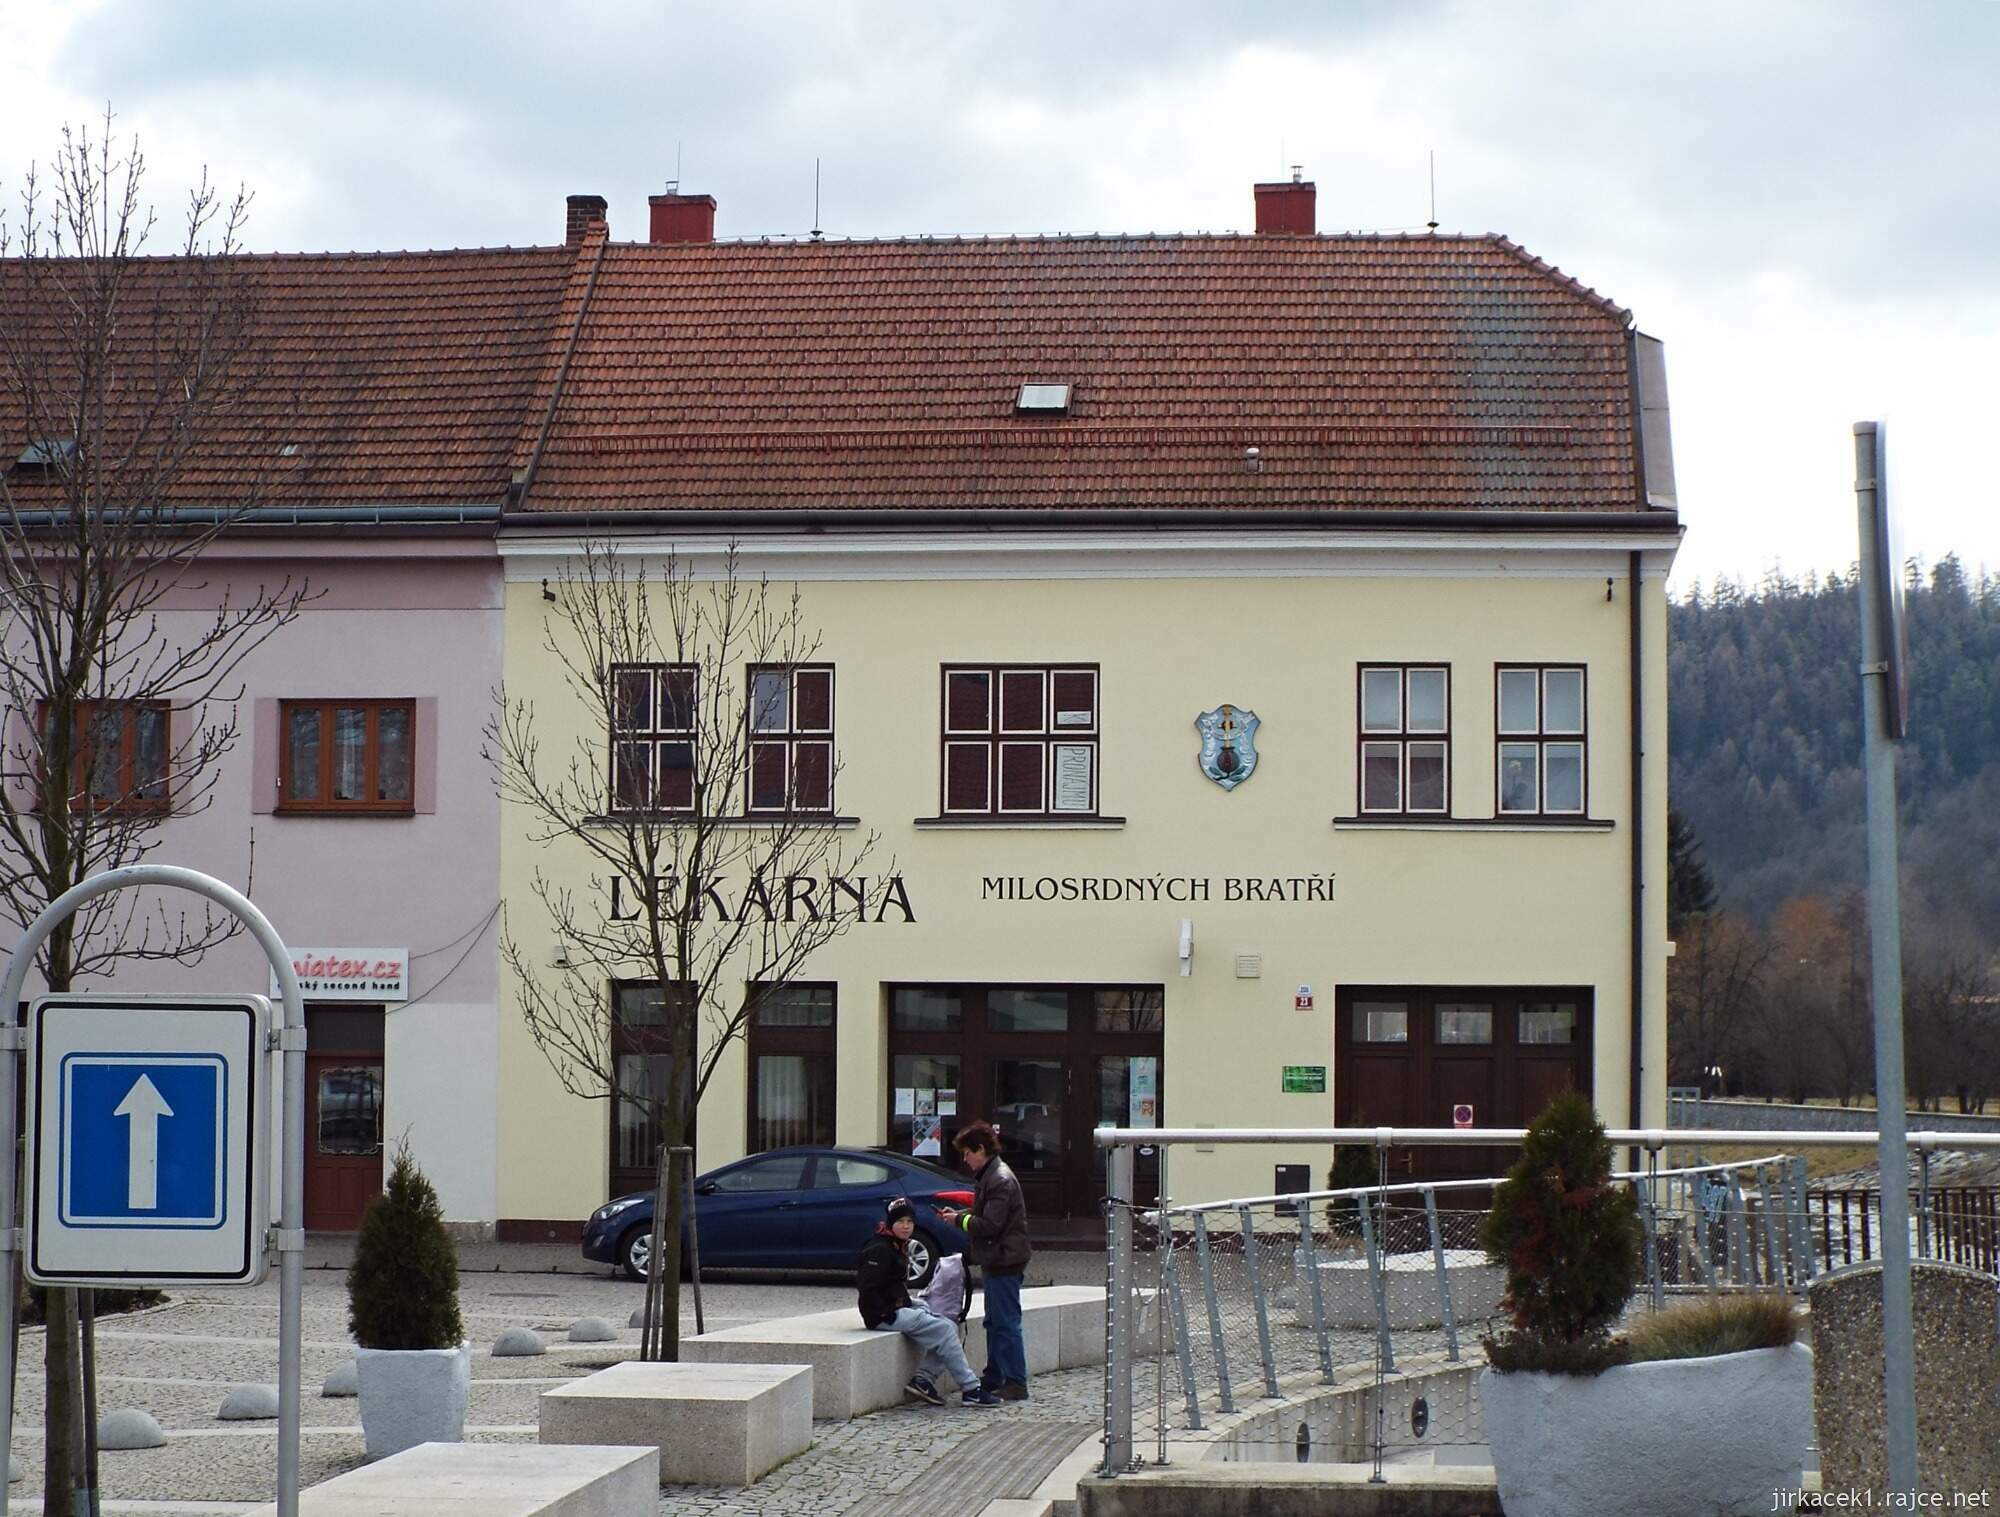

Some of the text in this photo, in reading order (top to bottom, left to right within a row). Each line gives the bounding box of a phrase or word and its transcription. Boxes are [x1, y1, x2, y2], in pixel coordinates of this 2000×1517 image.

[608, 864, 916, 923] LÉKÁRNA
[982, 872, 1336, 902] MILOSRDNÝCH BRATŘÍ
[323, 980, 367, 990] second
[372, 980, 400, 990] hand
